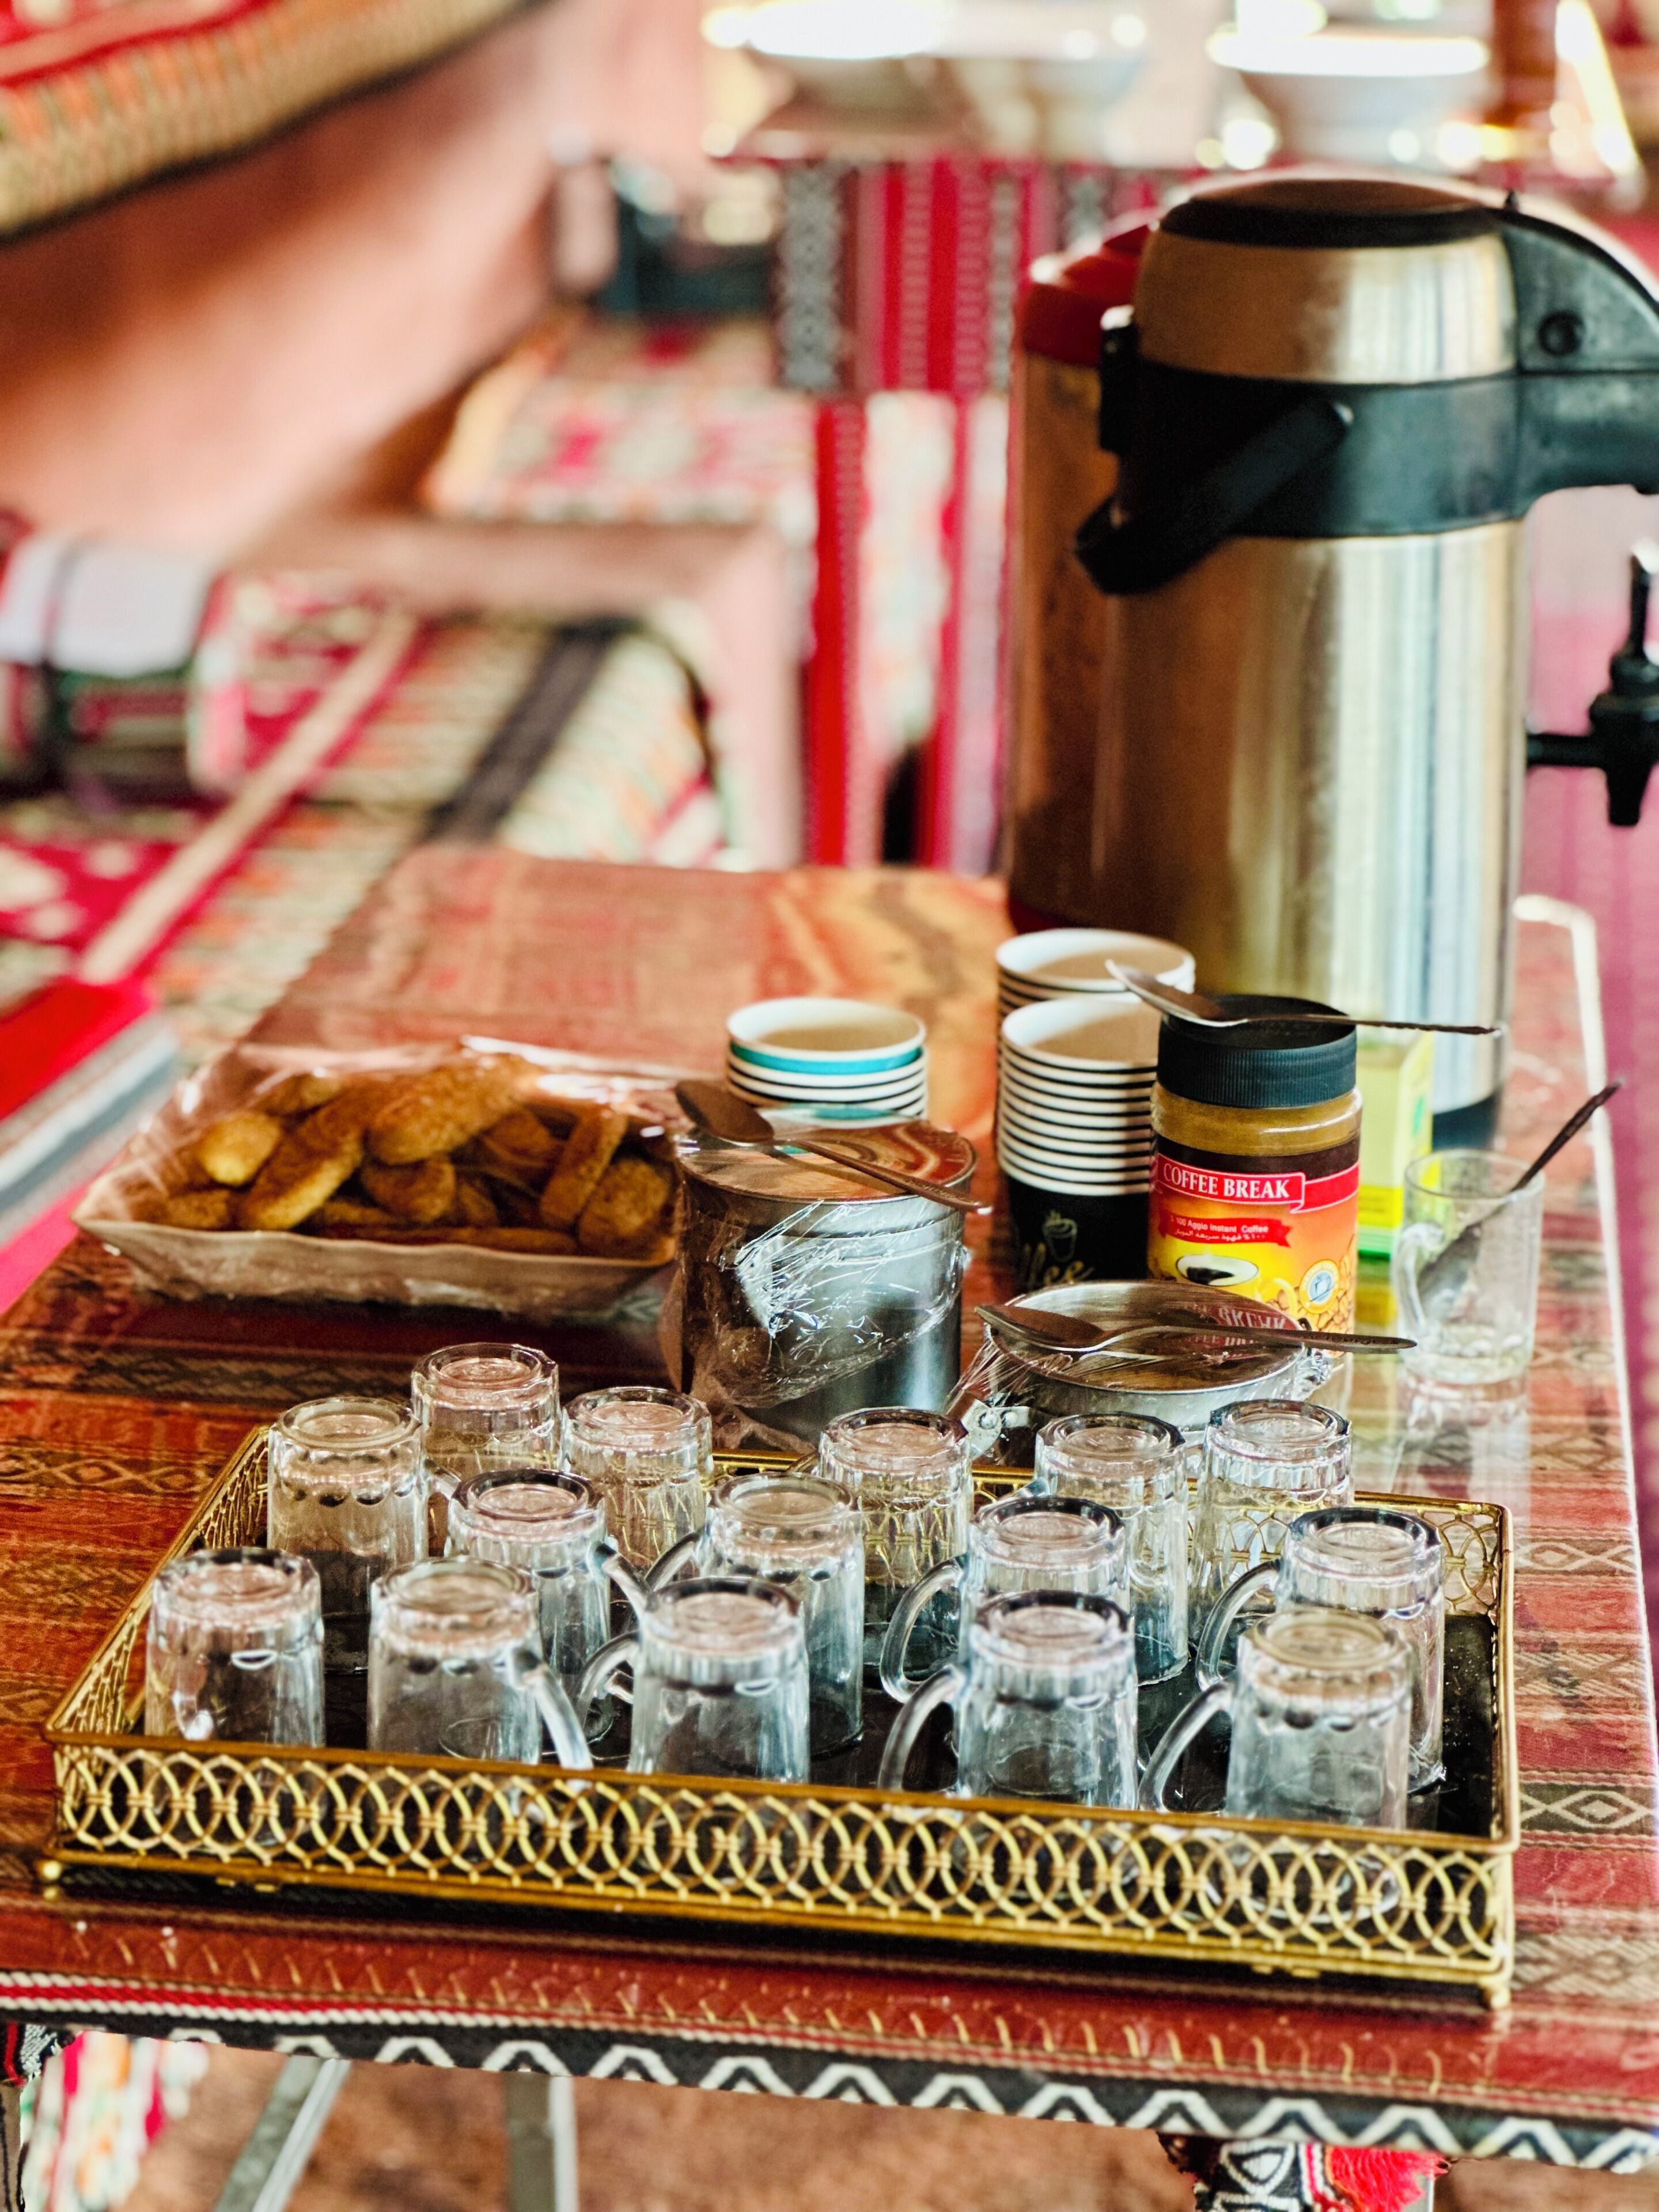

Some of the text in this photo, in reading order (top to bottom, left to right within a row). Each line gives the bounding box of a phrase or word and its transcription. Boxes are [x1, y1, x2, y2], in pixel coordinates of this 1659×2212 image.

[1163, 1163, 1290, 1199] COFFEE BREAK
[1241, 1225, 1269, 1233] Coffee
